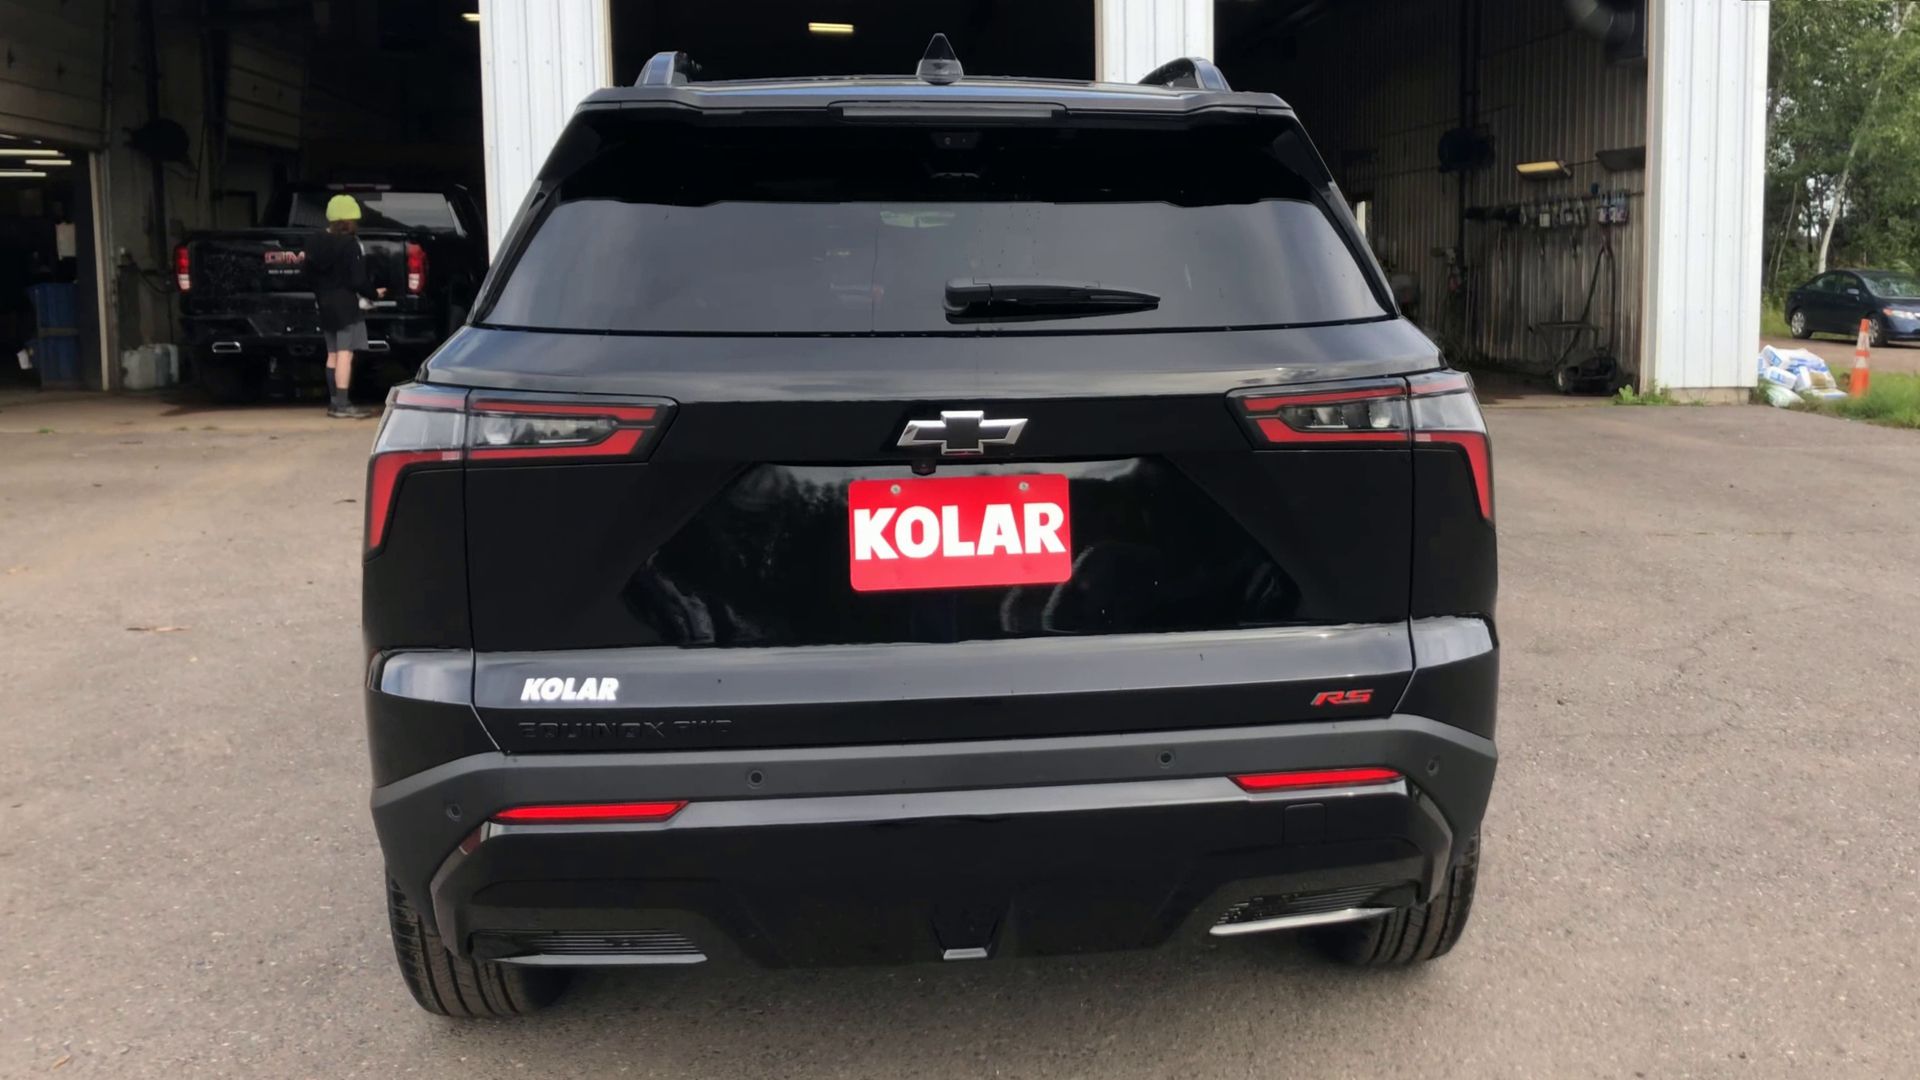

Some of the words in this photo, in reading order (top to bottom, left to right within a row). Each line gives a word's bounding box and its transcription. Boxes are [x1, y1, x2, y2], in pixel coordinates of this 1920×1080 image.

[264, 251, 305, 264] GM
[853, 502, 1067, 561] KOLAR
[520, 677, 620, 701] KOLAR
[1310, 689, 1374, 705] RS
[518, 721, 665, 738] EQUINOX
